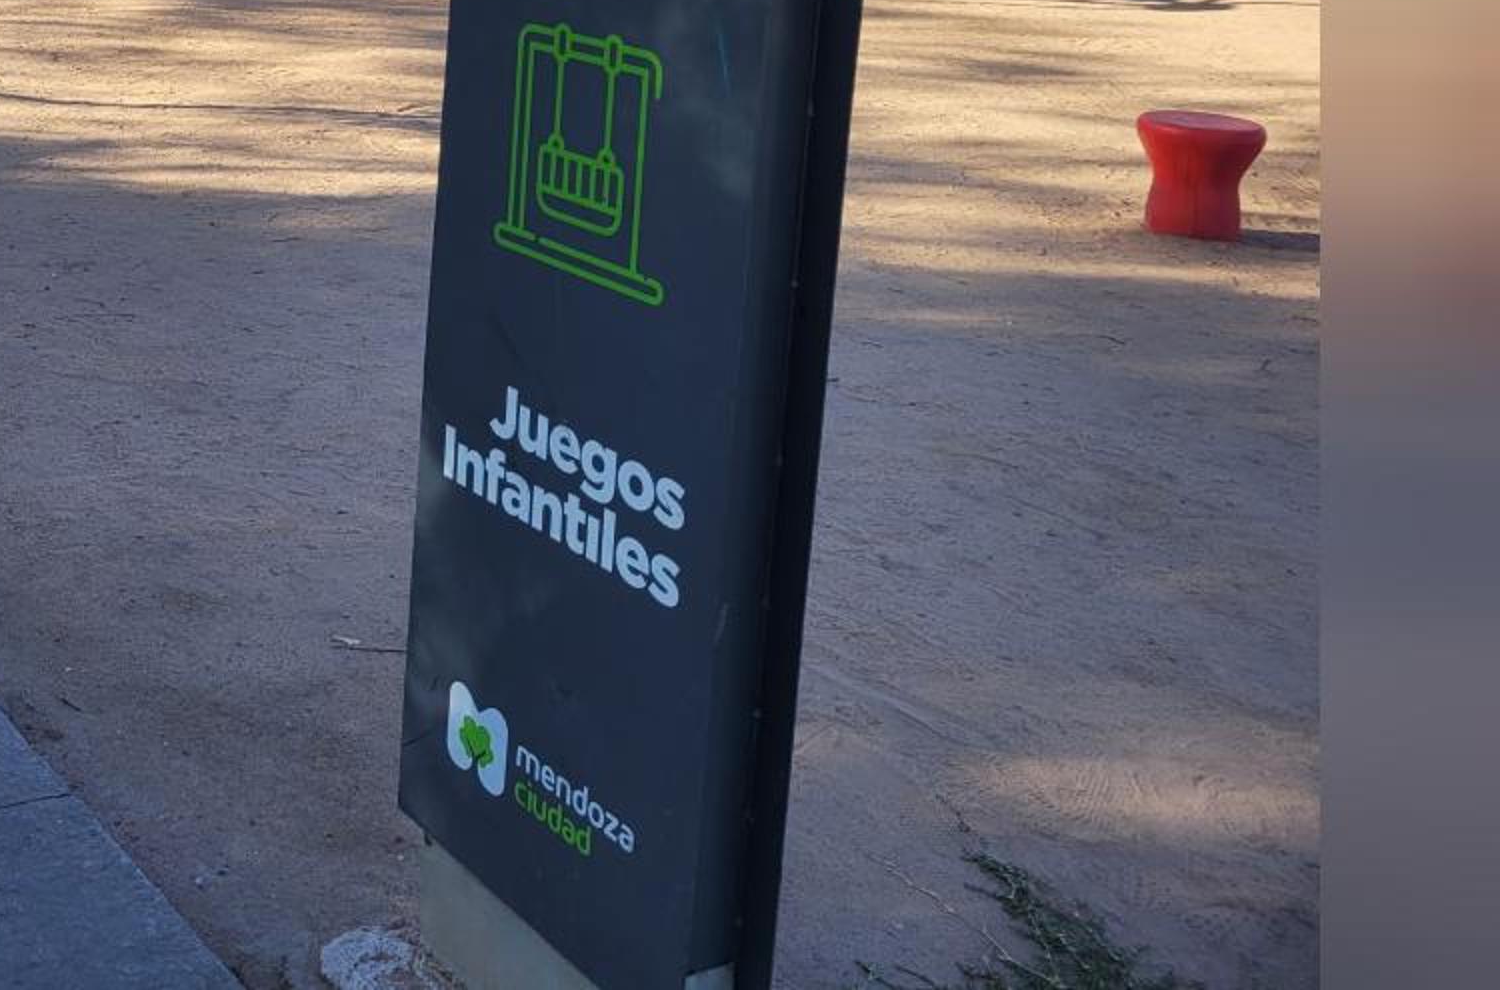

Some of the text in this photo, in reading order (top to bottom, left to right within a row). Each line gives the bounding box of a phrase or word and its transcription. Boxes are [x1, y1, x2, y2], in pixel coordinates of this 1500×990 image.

[442, 423, 681, 609] Infantiles
[489, 385, 686, 531] Juegos
[514, 778, 592, 856] ciudad
[515, 743, 636, 854] mendoza
